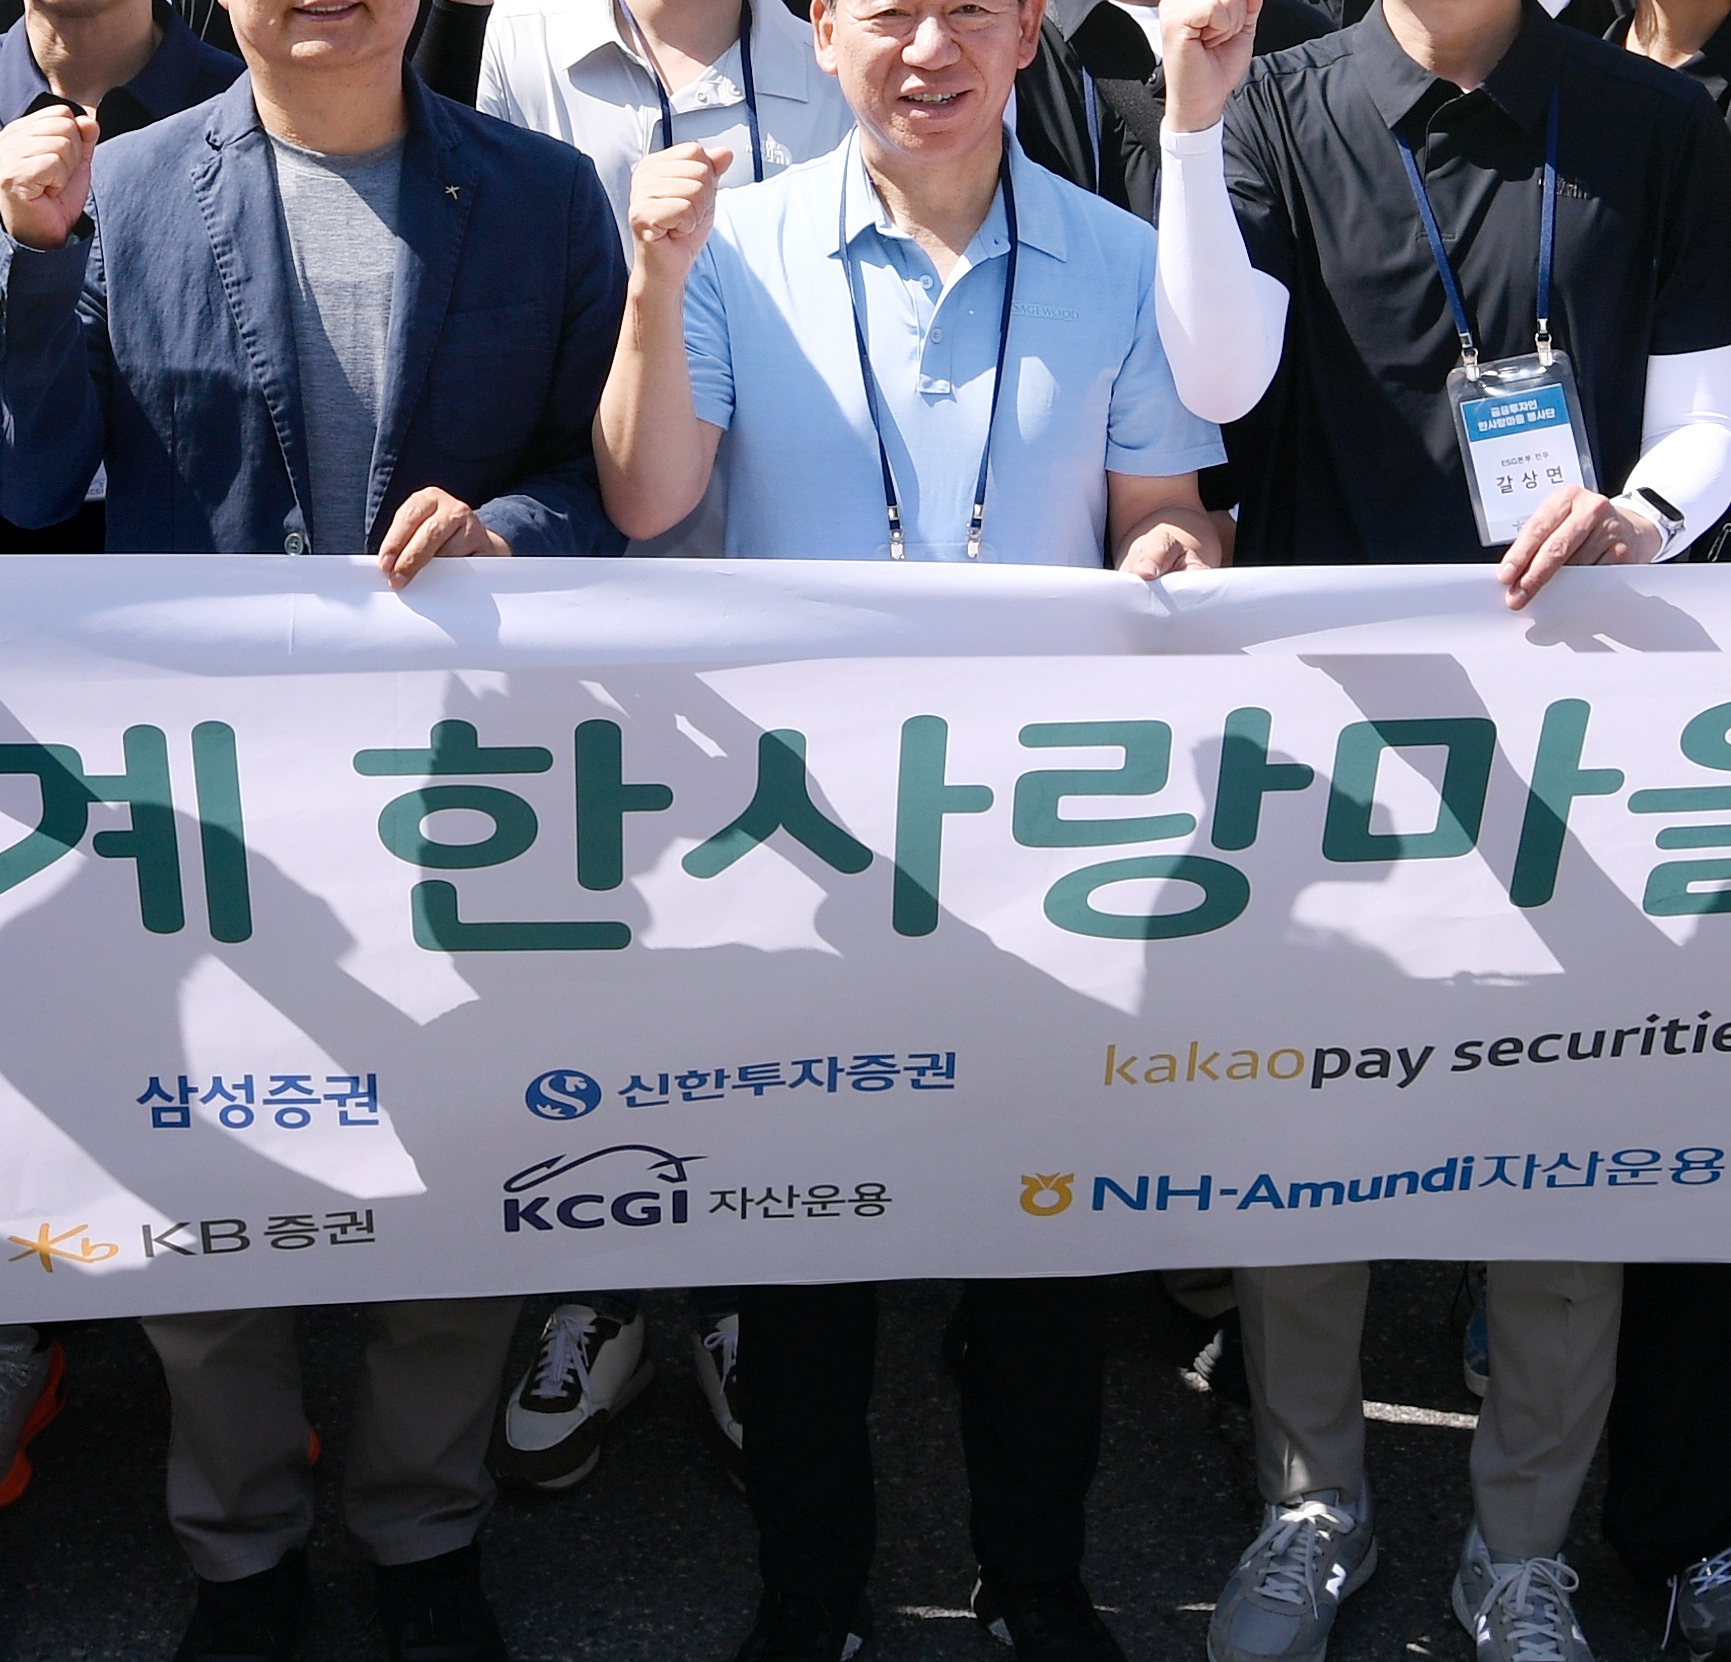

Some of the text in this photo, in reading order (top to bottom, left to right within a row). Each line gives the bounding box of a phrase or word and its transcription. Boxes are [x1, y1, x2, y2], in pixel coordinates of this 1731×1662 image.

[1478, 408, 1556, 432] 한사랑마을 봉사단
[1490, 398, 1538, 417] 금융투자인
[617, 1051, 958, 1108] 신한투자증권
[1104, 1040, 1436, 1090] kakaopay
[135, 1071, 380, 1130] 삼성증권
[1091, 1147, 1726, 1211] NH-Amundi자산운용
[503, 1190, 689, 1232] KCGI
[708, 1182, 894, 1222] 자산운용
[262, 1209, 377, 1250] 증권
